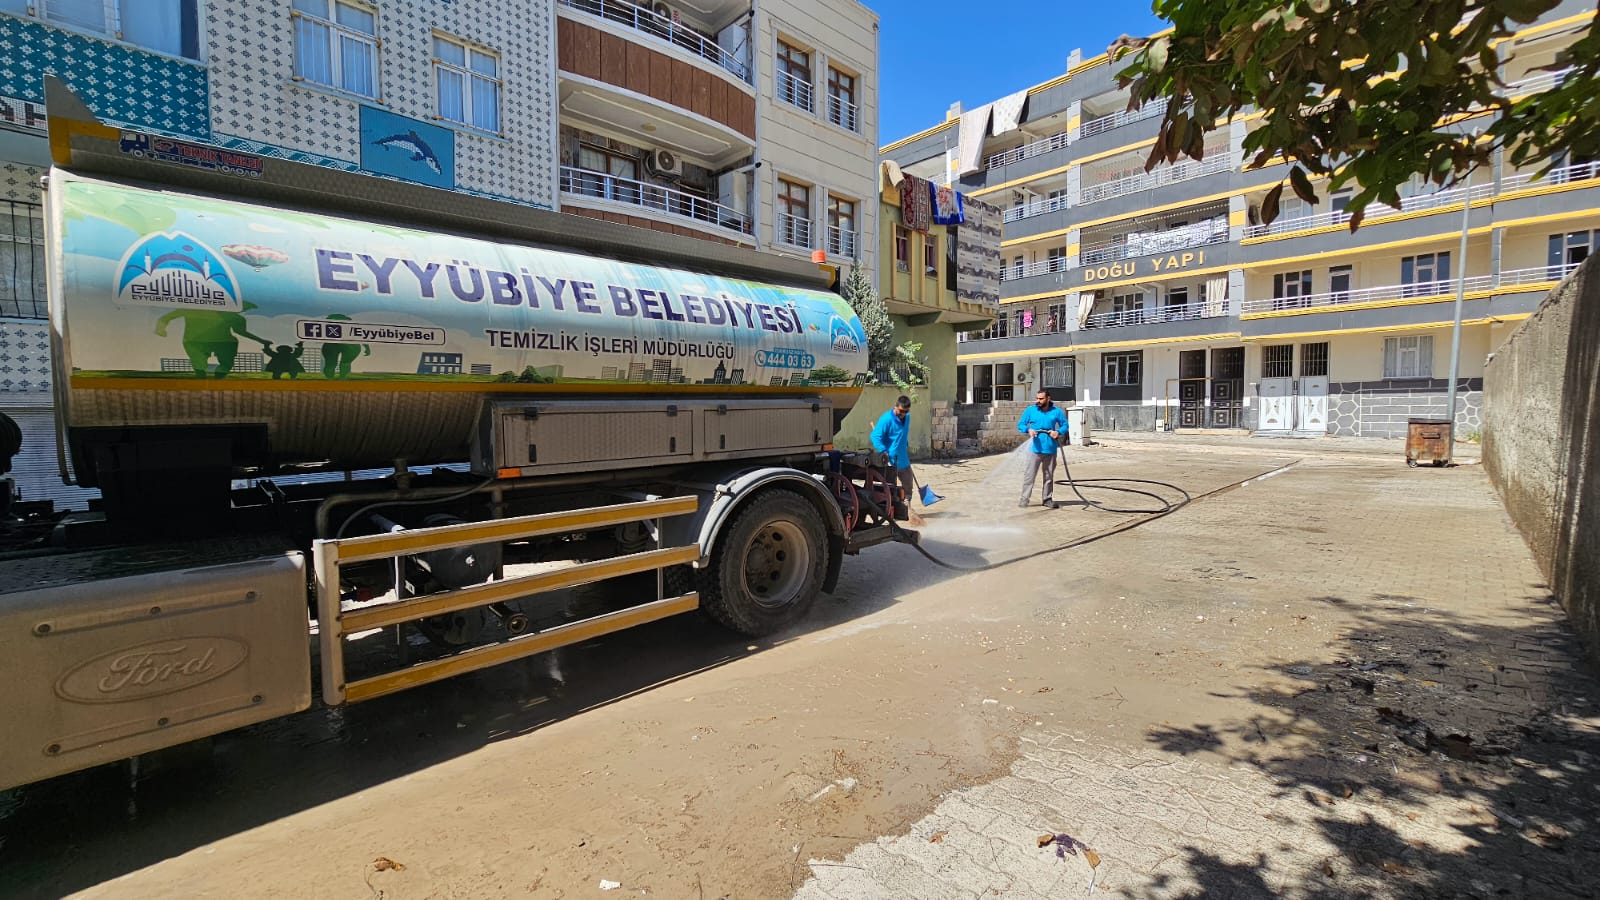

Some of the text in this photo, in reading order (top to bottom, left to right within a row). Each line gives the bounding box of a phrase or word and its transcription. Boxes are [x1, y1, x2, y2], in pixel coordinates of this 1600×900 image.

[1085, 251, 1204, 282] DOĞU YAPI
[315, 248, 804, 334] EYYÜBİYE BELEDİYESİ
[349, 327, 434, 341] /EyyübiyeBel
[485, 328, 735, 360] TEMİZLİK İŞLERİ MÜDÜRLÜĞÜ
[767, 352, 812, 368] 444 03 63
[98, 645, 216, 693] Ford
